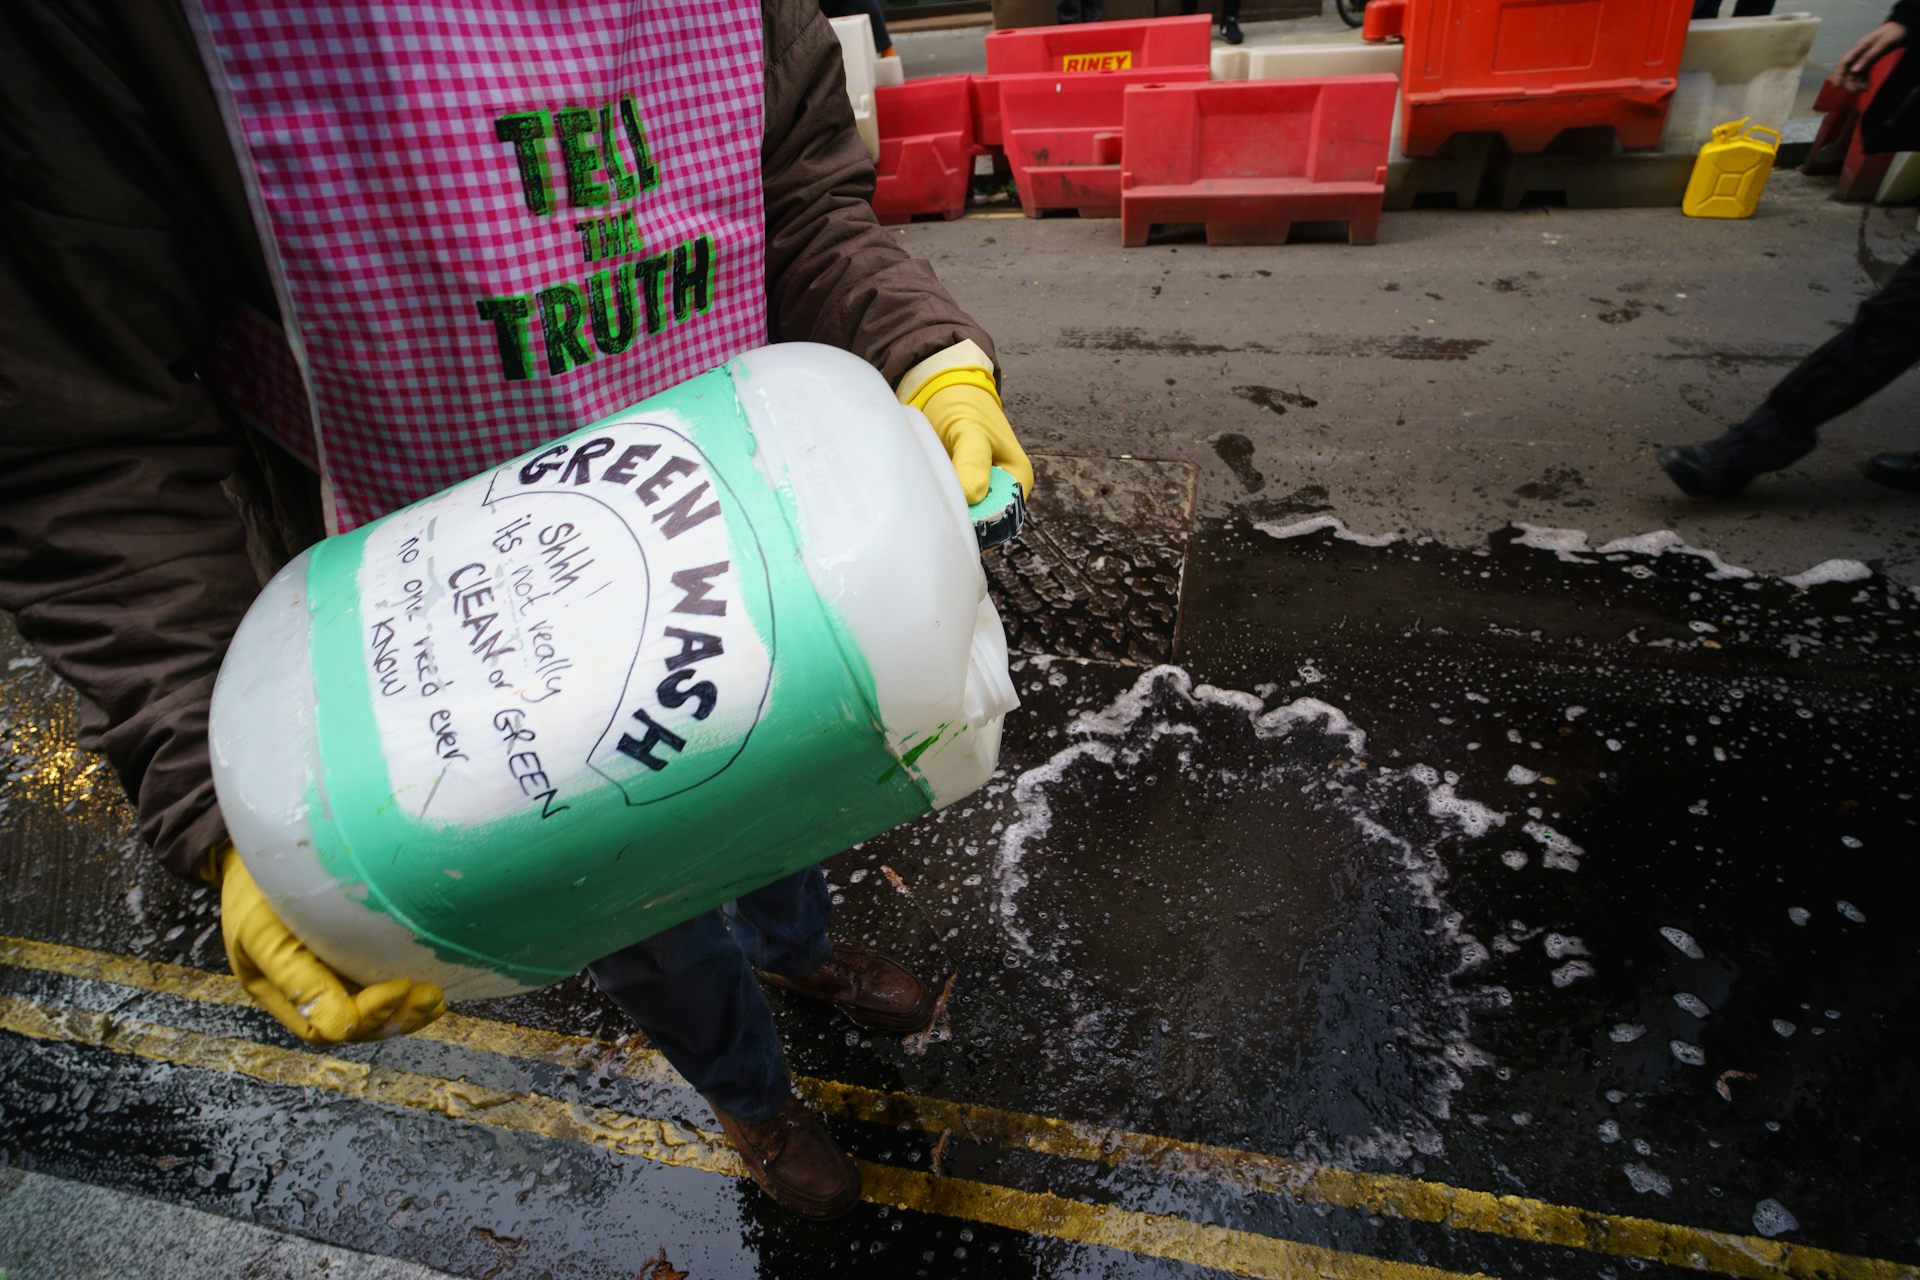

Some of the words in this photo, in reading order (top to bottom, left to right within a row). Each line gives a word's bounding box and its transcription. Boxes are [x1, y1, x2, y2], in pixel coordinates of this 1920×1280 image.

[1066, 55, 1128, 72] RINEY
[494, 93, 660, 217] TELL
[574, 208, 644, 262] THE
[476, 233, 717, 381] TRUTH
[492, 513, 532, 554] its
[518, 436, 723, 541] GREEN
[448, 562, 516, 664] CLEAN
[511, 564, 551, 616] not
[397, 536, 420, 564] no
[429, 709, 469, 762] ever
[488, 669, 515, 689] or
[521, 619, 574, 703] really
[616, 560, 731, 772] WASH
[493, 709, 571, 819] GREEN
